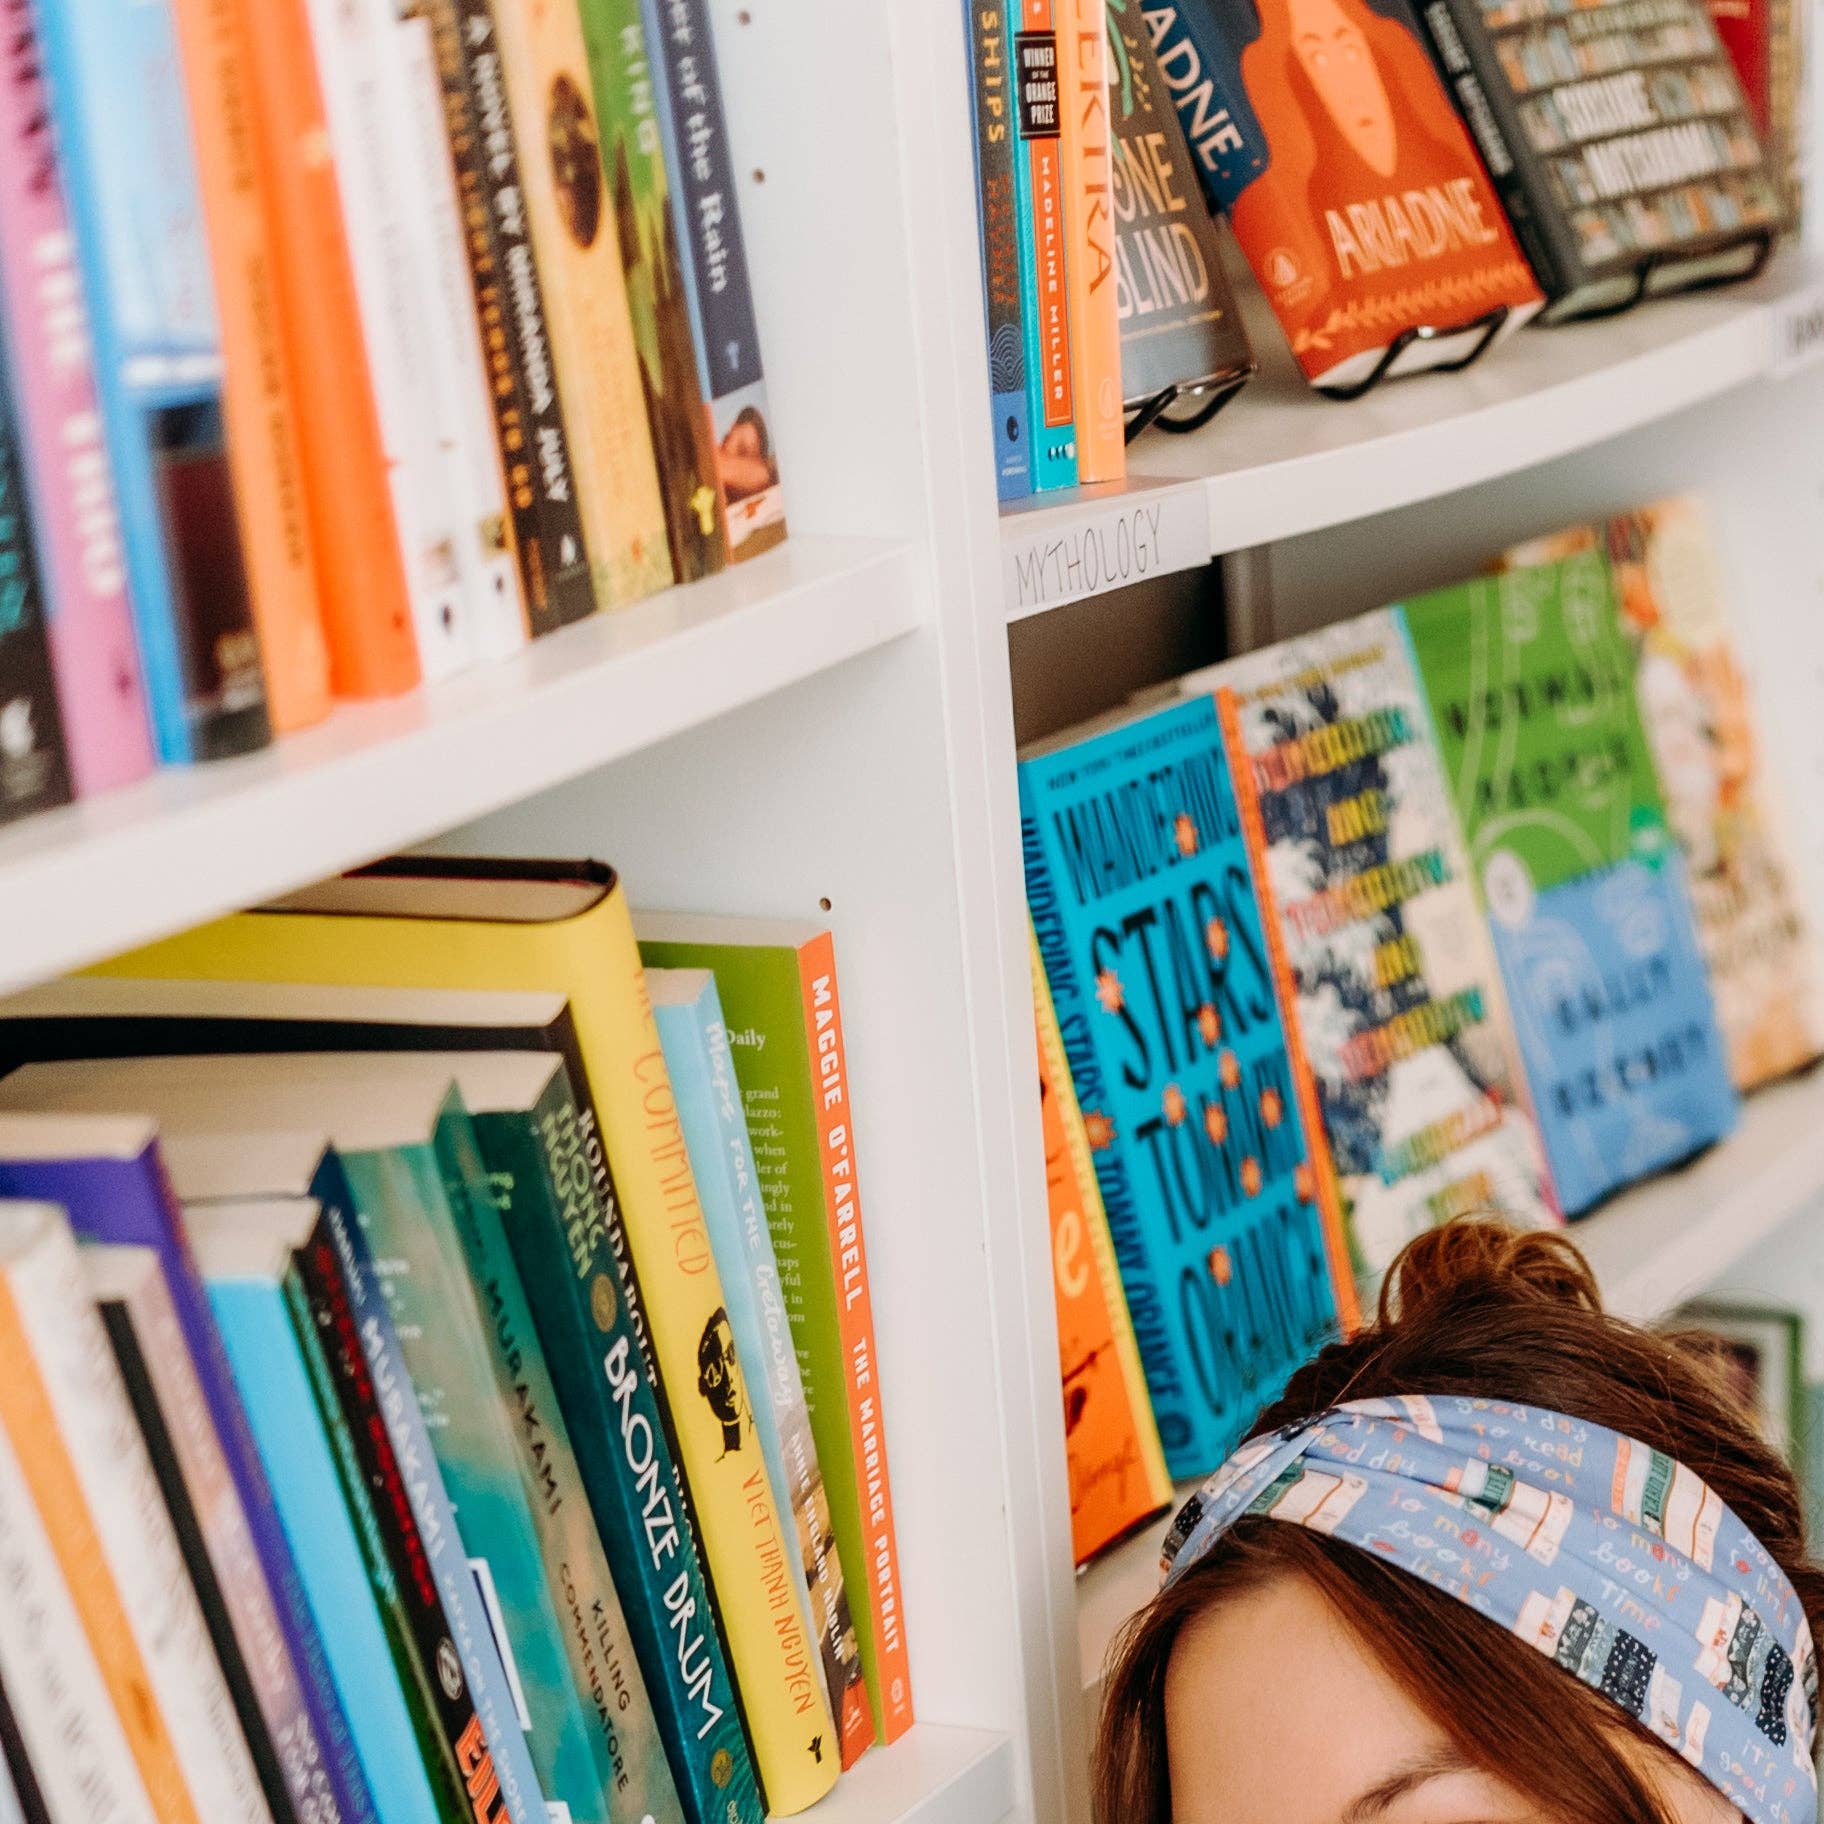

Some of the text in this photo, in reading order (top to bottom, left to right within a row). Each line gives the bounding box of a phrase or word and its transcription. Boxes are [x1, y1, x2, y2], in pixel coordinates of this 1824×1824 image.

[978, 10, 1006, 146] SHIPS
[1023, 46, 1056, 69] WINNER
[1025, 82, 1058, 103] ORANGE
[471, 52, 524, 236] NOVEL BY
[1031, 104, 1055, 126] PRIZE
[686, 112, 730, 295] the Rain
[1325, 177, 1499, 280] ARIADNE
[1040, 156, 1065, 401] MADELINE MILLER
[1016, 503, 1162, 606] MYTHOLOGY
[1089, 864, 1274, 1091] STARS
[726, 1028, 767, 1054] Daily
[745, 1088, 780, 1102] grand
[1020, 817, 1180, 1398] WANDERING STARS TOMMY ORANGE
[753, 1144, 787, 1157] when
[774, 1161, 789, 1175] of
[705, 1020, 736, 1124] Maps
[729, 1136, 749, 1193] FOR
[741, 1201, 762, 1250] THE
[755, 1263, 795, 1407] Getaway
[780, 1201, 793, 1213] in
[811, 974, 901, 1656] MAGGIE O'FARRELL THE MARRIAGE PORTRAIT
[486, 1277, 563, 1517] MURAKAMI
[633, 1048, 814, 1717] COMMITTED VIET THANH NGUYEN
[1540, 1413, 1589, 1446] day
[360, 1314, 447, 1561] MURAKAMI
[1505, 1448, 1577, 1489] book
[1524, 1435, 1584, 1469] read
[603, 1334, 681, 1572] BRONZE
[662, 1570, 724, 1740] DRUM
[1432, 1514, 1512, 1572] many
[1591, 1541, 1681, 1602] books
[1630, 1532, 1692, 1581] many
[558, 1561, 631, 1795] COMMENDATORE
[590, 1598, 632, 1713] KILLING
